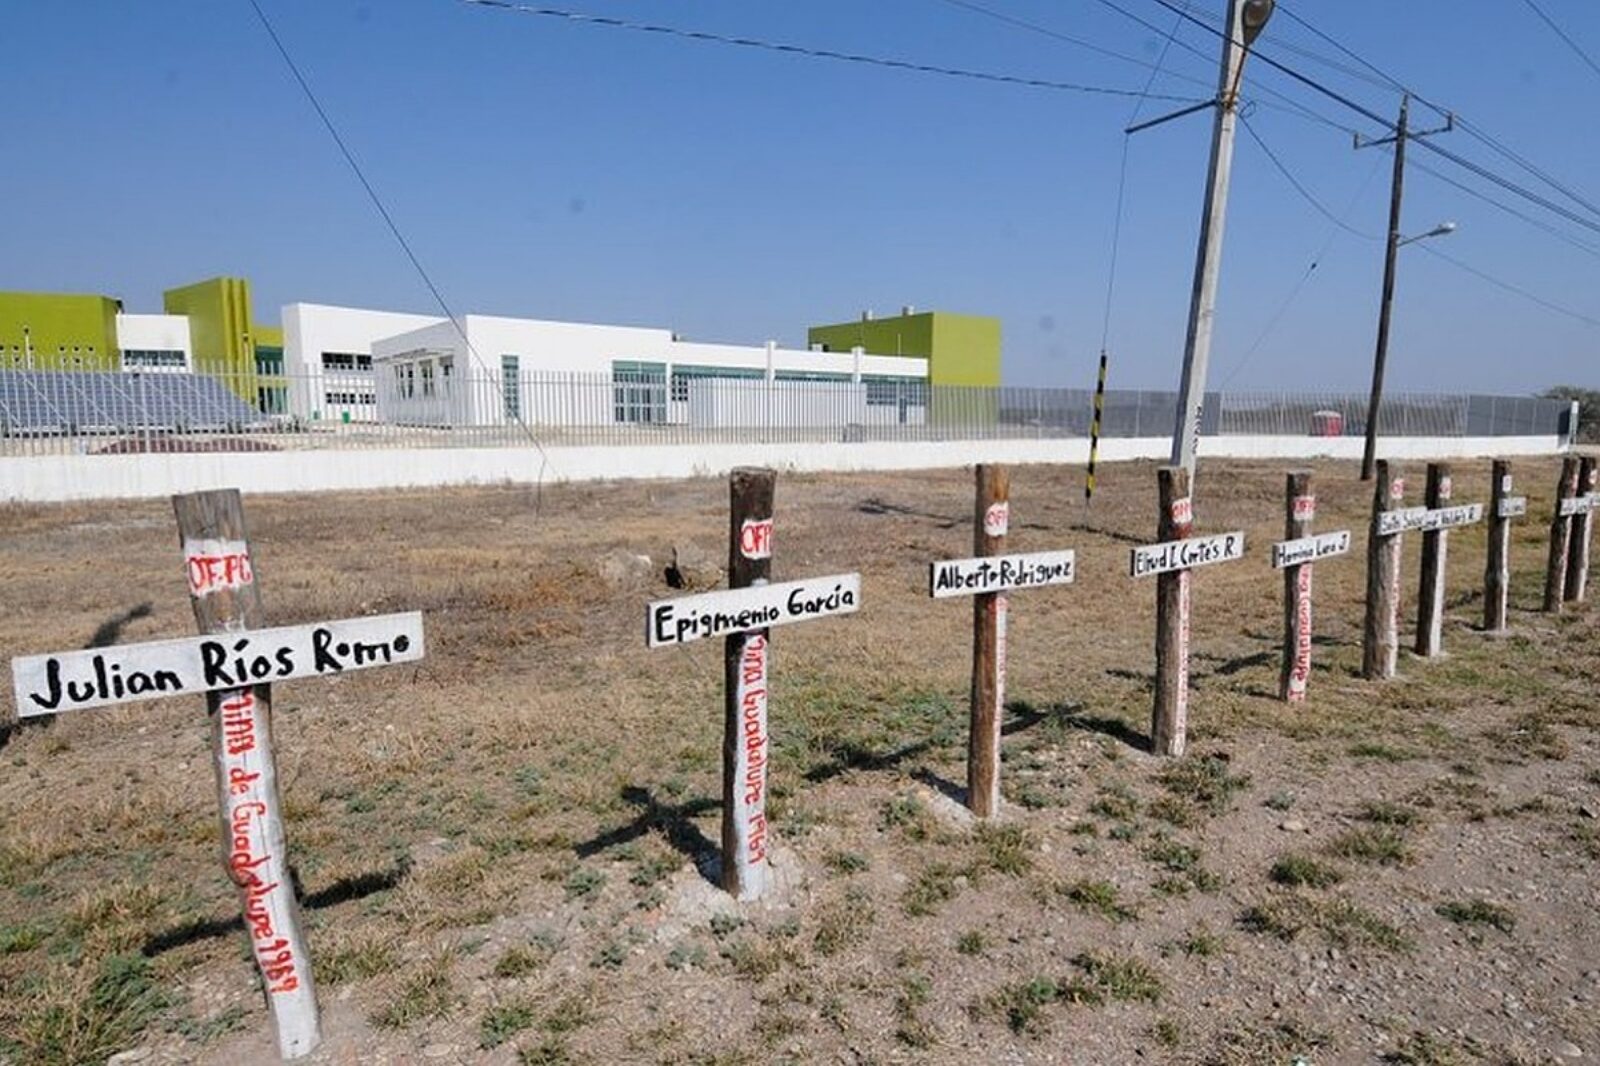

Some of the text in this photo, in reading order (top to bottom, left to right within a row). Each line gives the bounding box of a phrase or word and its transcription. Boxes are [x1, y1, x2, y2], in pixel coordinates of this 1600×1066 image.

[936, 559, 1071, 590] Alberto Rodriguez
[655, 584, 854, 642] Epigmenio García
[30, 628, 410, 710] Julian Ríos Romo
[228, 765, 261, 796] de
[743, 689, 768, 806] Guadalupe
[228, 801, 279, 942] Guadalupe
